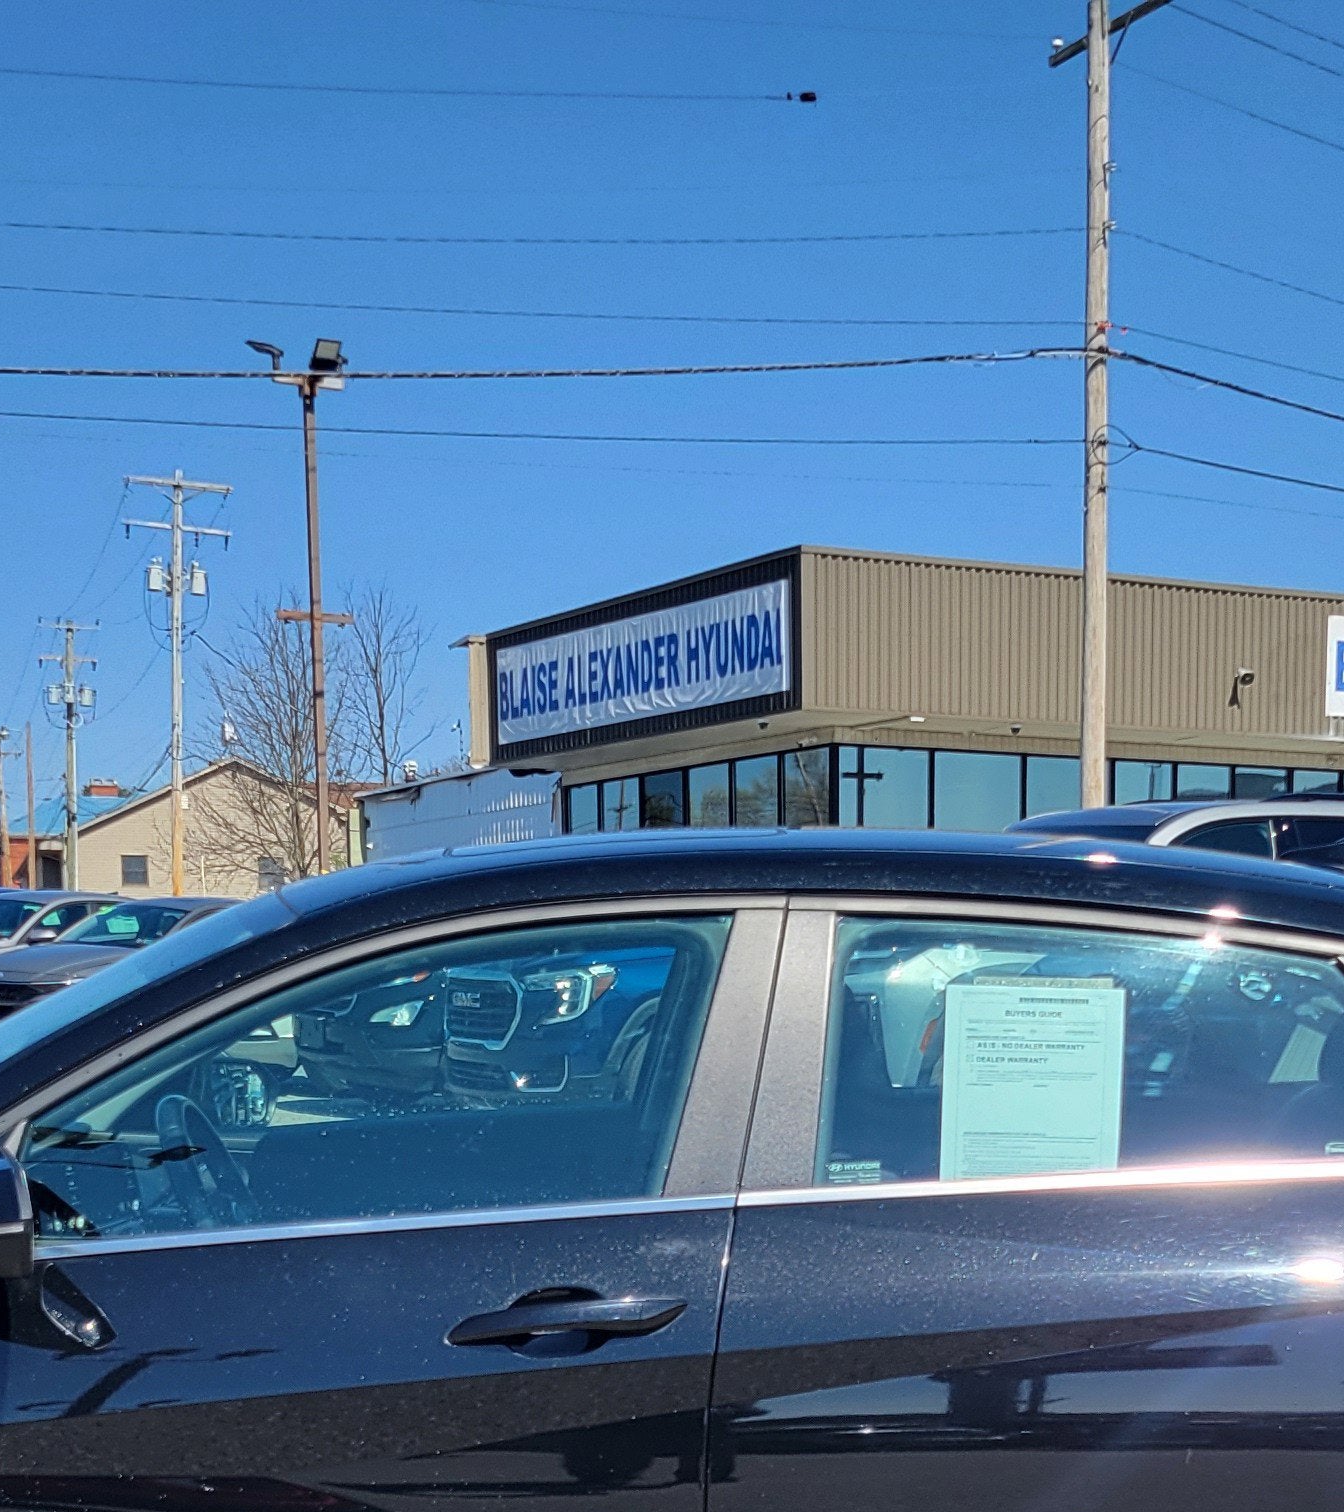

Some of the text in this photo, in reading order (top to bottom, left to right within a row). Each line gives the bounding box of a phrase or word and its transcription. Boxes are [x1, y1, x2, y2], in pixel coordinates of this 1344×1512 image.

[499, 608, 782, 721] BLAISE ALEXANDER HYUNDAI
[1004, 1009, 1063, 1019] BUYERS GUIDE
